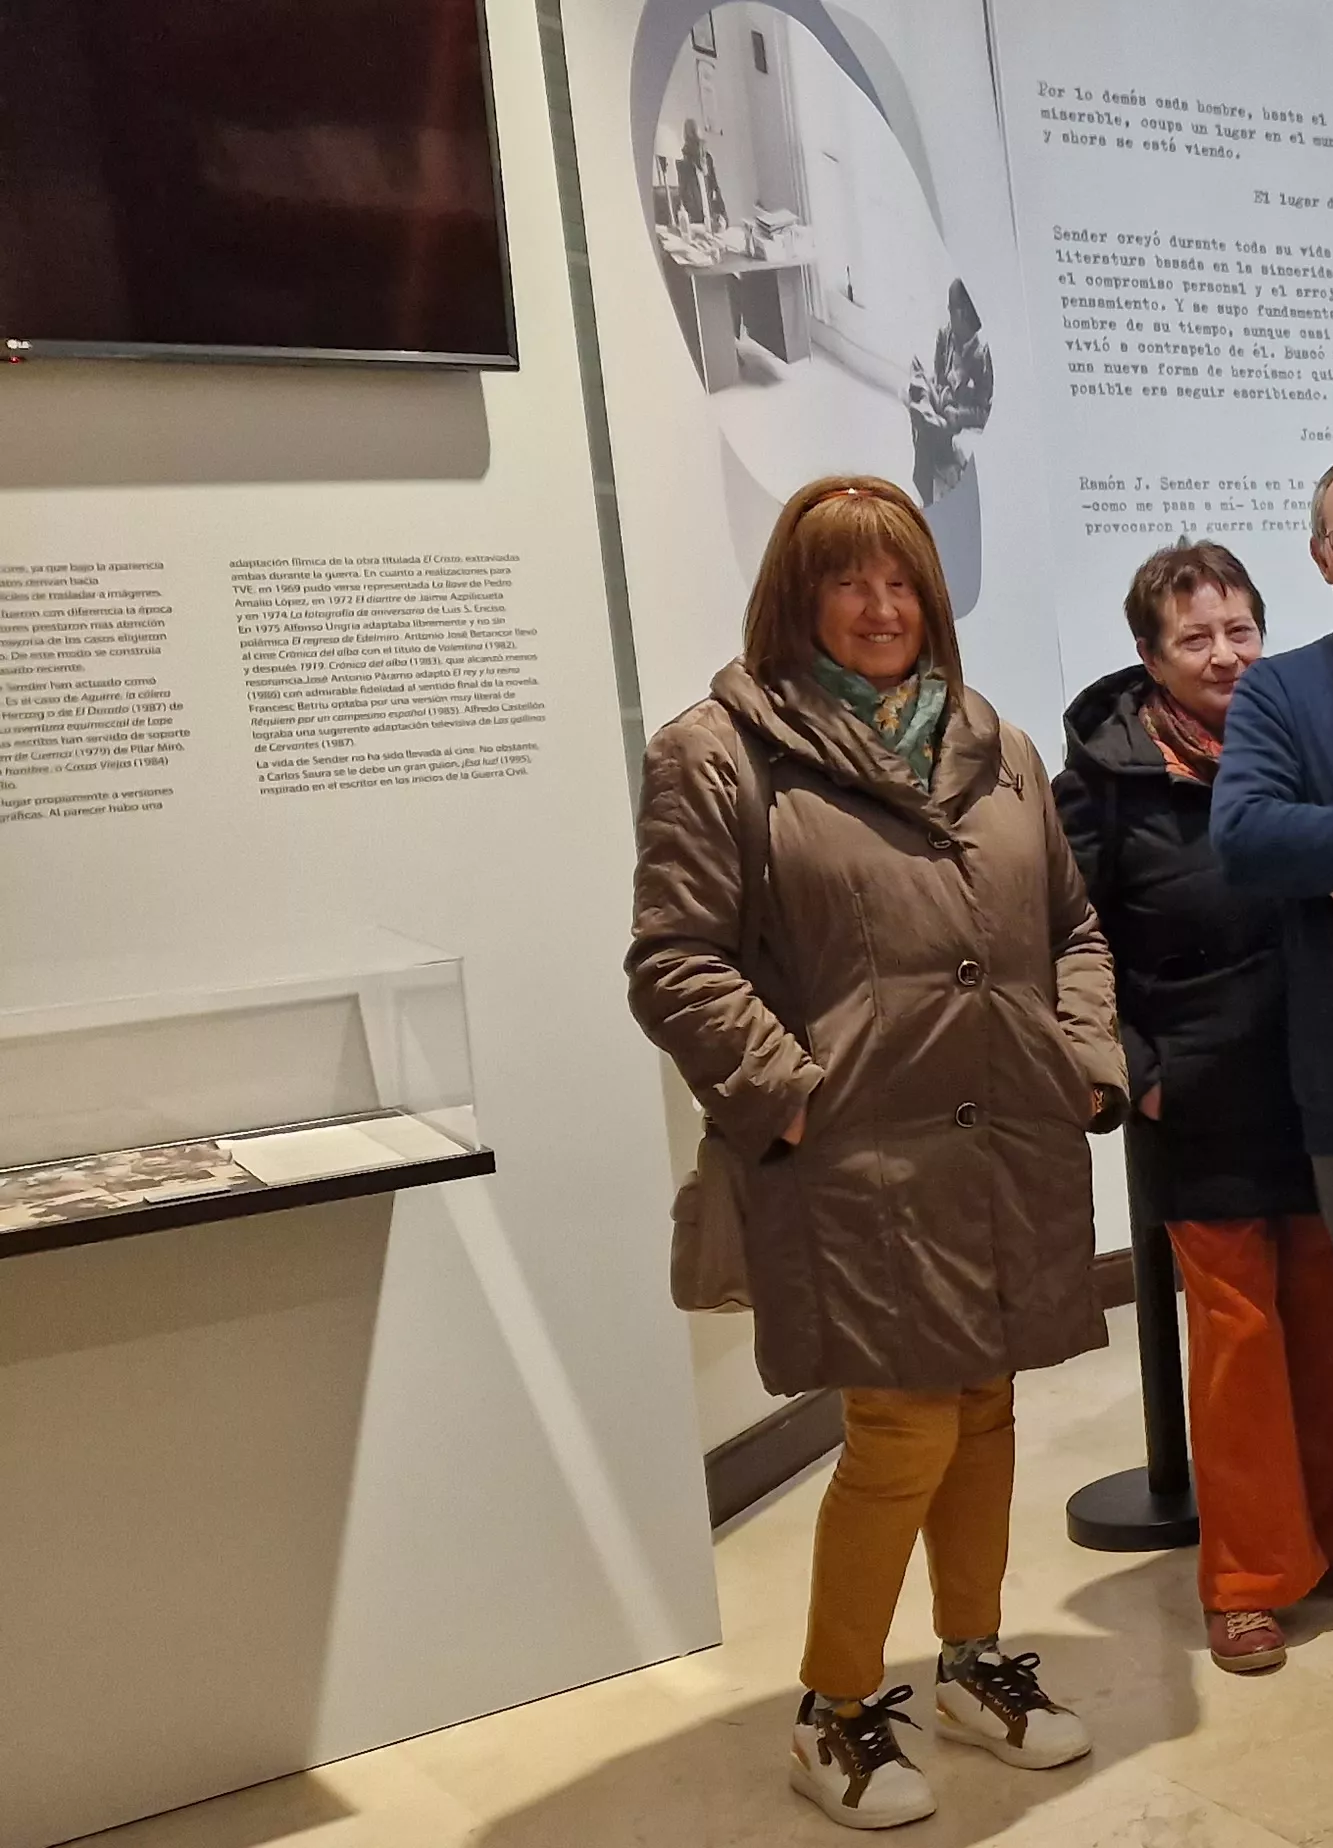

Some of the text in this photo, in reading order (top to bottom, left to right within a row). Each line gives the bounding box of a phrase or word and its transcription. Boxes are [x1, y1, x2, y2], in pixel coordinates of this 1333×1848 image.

[1040, 106, 1130, 128] miserable,
[1140, 117, 1183, 133] ocupa
[1190, 122, 1208, 135] un
[1214, 123, 1256, 140] lugar
[1264, 131, 1281, 142] en
[1289, 131, 1305, 145] el
[1042, 129, 1240, 159] y ahora se está viendo.
[1253, 189, 1270, 204] El
[1279, 191, 1320, 209] lugar
[1052, 224, 1107, 243] Sender
[1117, 233, 1160, 253] creyó
[1169, 234, 1226, 251] durante
[1234, 239, 1267, 254] toda
[1275, 245, 1292, 256] su
[1299, 244, 1331, 258] vida
[1055, 248, 1145, 267] literatura
[1154, 254, 1204, 271] basada
[1212, 261, 1229, 273] en
[1236, 260, 1252, 274] la
[228, 558, 289, 569] adaptación
[328, 556, 342, 565] de
[344, 556, 354, 565] la
[356, 556, 380, 565] obra
[381, 555, 421, 564] titulada
